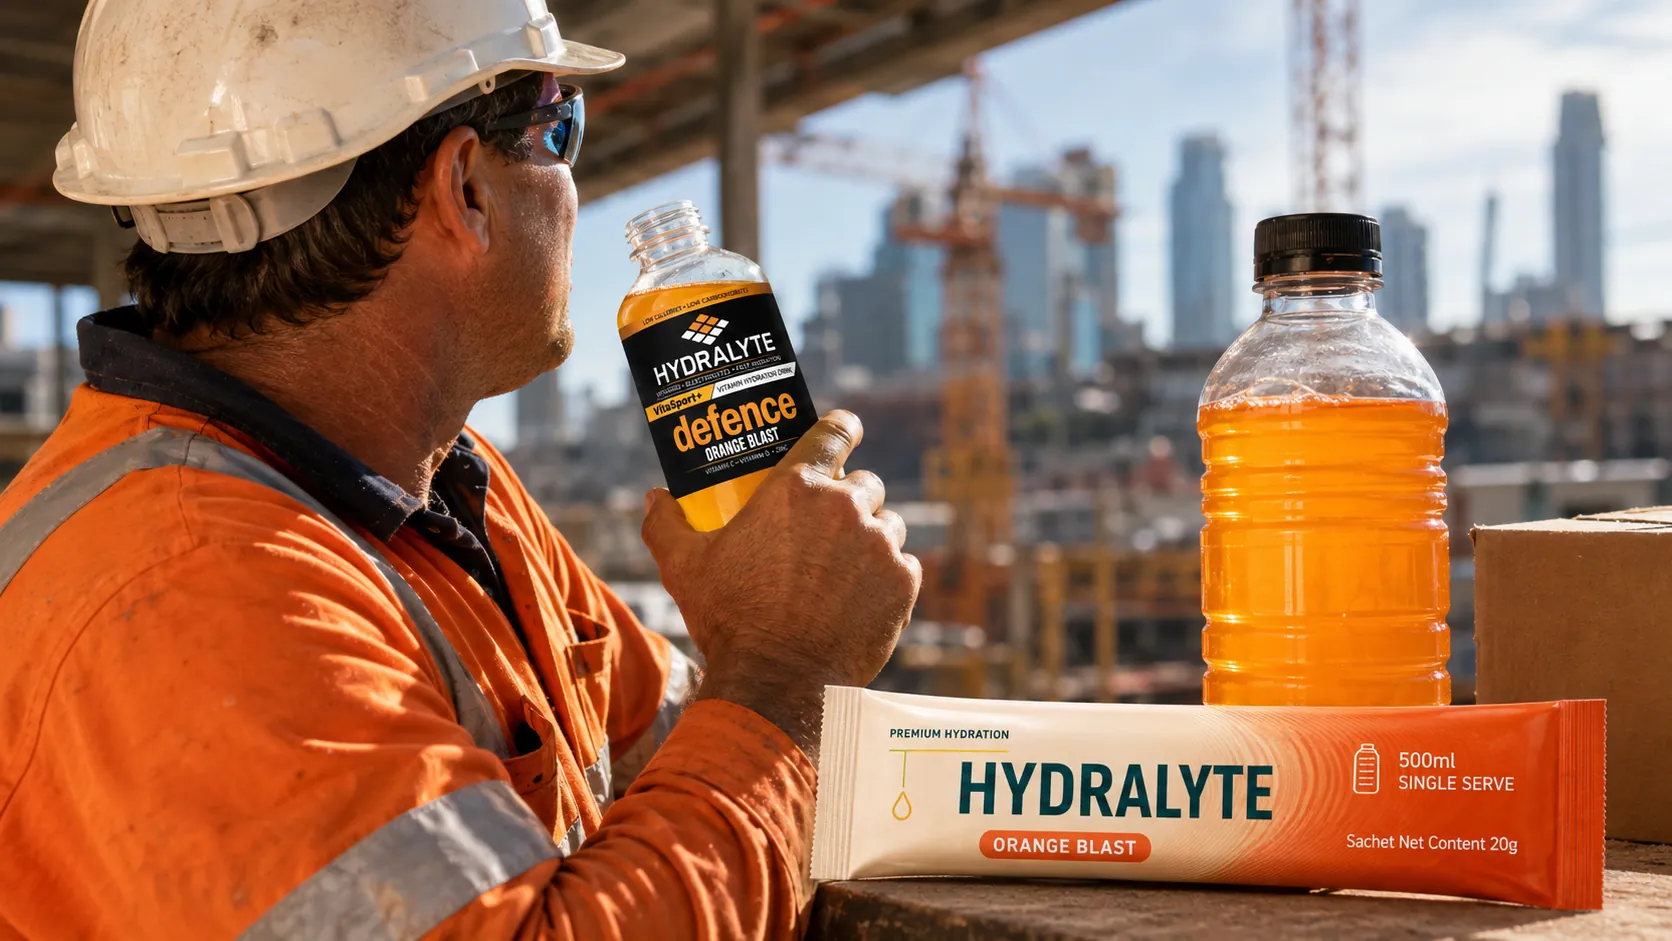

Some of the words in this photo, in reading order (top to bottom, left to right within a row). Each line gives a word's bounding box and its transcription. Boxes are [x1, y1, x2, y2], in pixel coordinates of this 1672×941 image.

[653, 332, 776, 386] HYDRALYTE
[653, 392, 703, 416] VitaSport+
[673, 392, 797, 453] defence
[704, 437, 747, 462] ORANGE
[746, 426, 780, 449] BLAST
[889, 728, 941, 739] PREMIUM
[944, 729, 1010, 740] HYDRATION
[1399, 751, 1456, 769] 500ml
[958, 761, 1273, 820] HYDRALYTE
[1398, 775, 1457, 791] SINGLE
[1462, 776, 1515, 792] SERVE
[993, 837, 1070, 855] ORANGE
[1077, 839, 1137, 856] BLAST
[1346, 833, 1395, 849] Sachet
[1399, 835, 1424, 850] Net
[1428, 835, 1486, 851] Content
[1490, 836, 1518, 855] 20g
